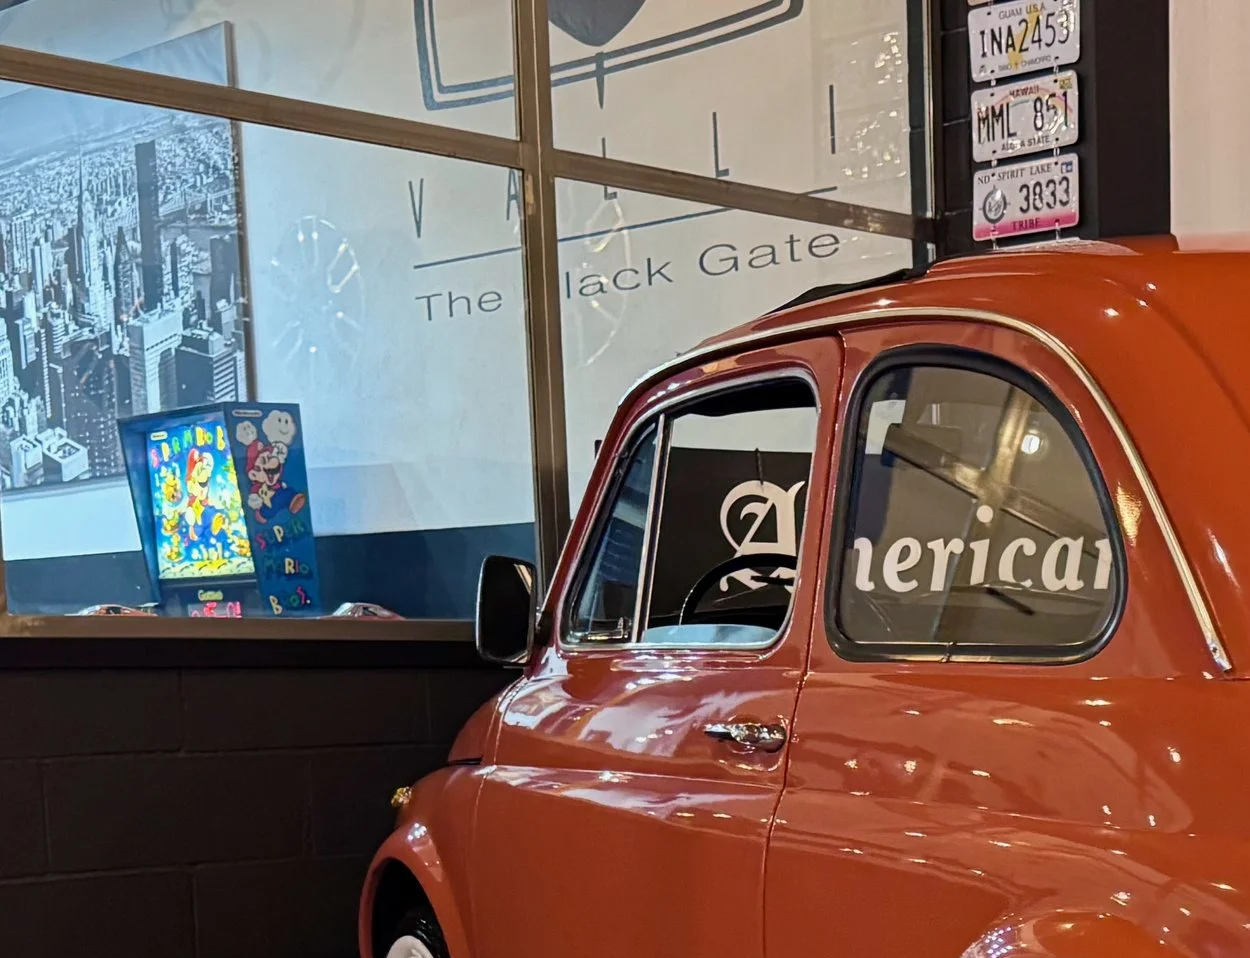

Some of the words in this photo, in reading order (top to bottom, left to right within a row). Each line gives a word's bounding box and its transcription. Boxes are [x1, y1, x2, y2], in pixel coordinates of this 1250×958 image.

[999, 8, 1022, 20] GUAM
[1009, 85, 1040, 98] HAWAII
[977, 101, 1017, 145] MML
[1033, 90, 1068, 131] 851
[1001, 139, 1026, 151] ALOA
[1028, 134, 1051, 148] STATE
[978, 175, 991, 185] ND
[997, 167, 1026, 181] SPIRIT
[1030, 162, 1053, 176] LAKE
[1019, 176, 1071, 213] 3833
[1011, 217, 1041, 231] TRIBE
[415, 290, 503, 321] The
[565, 257, 673, 299] lack
[699, 232, 840, 276] Gate
[256, 518, 307, 551] SUPR
[269, 586, 311, 615] BOS.
